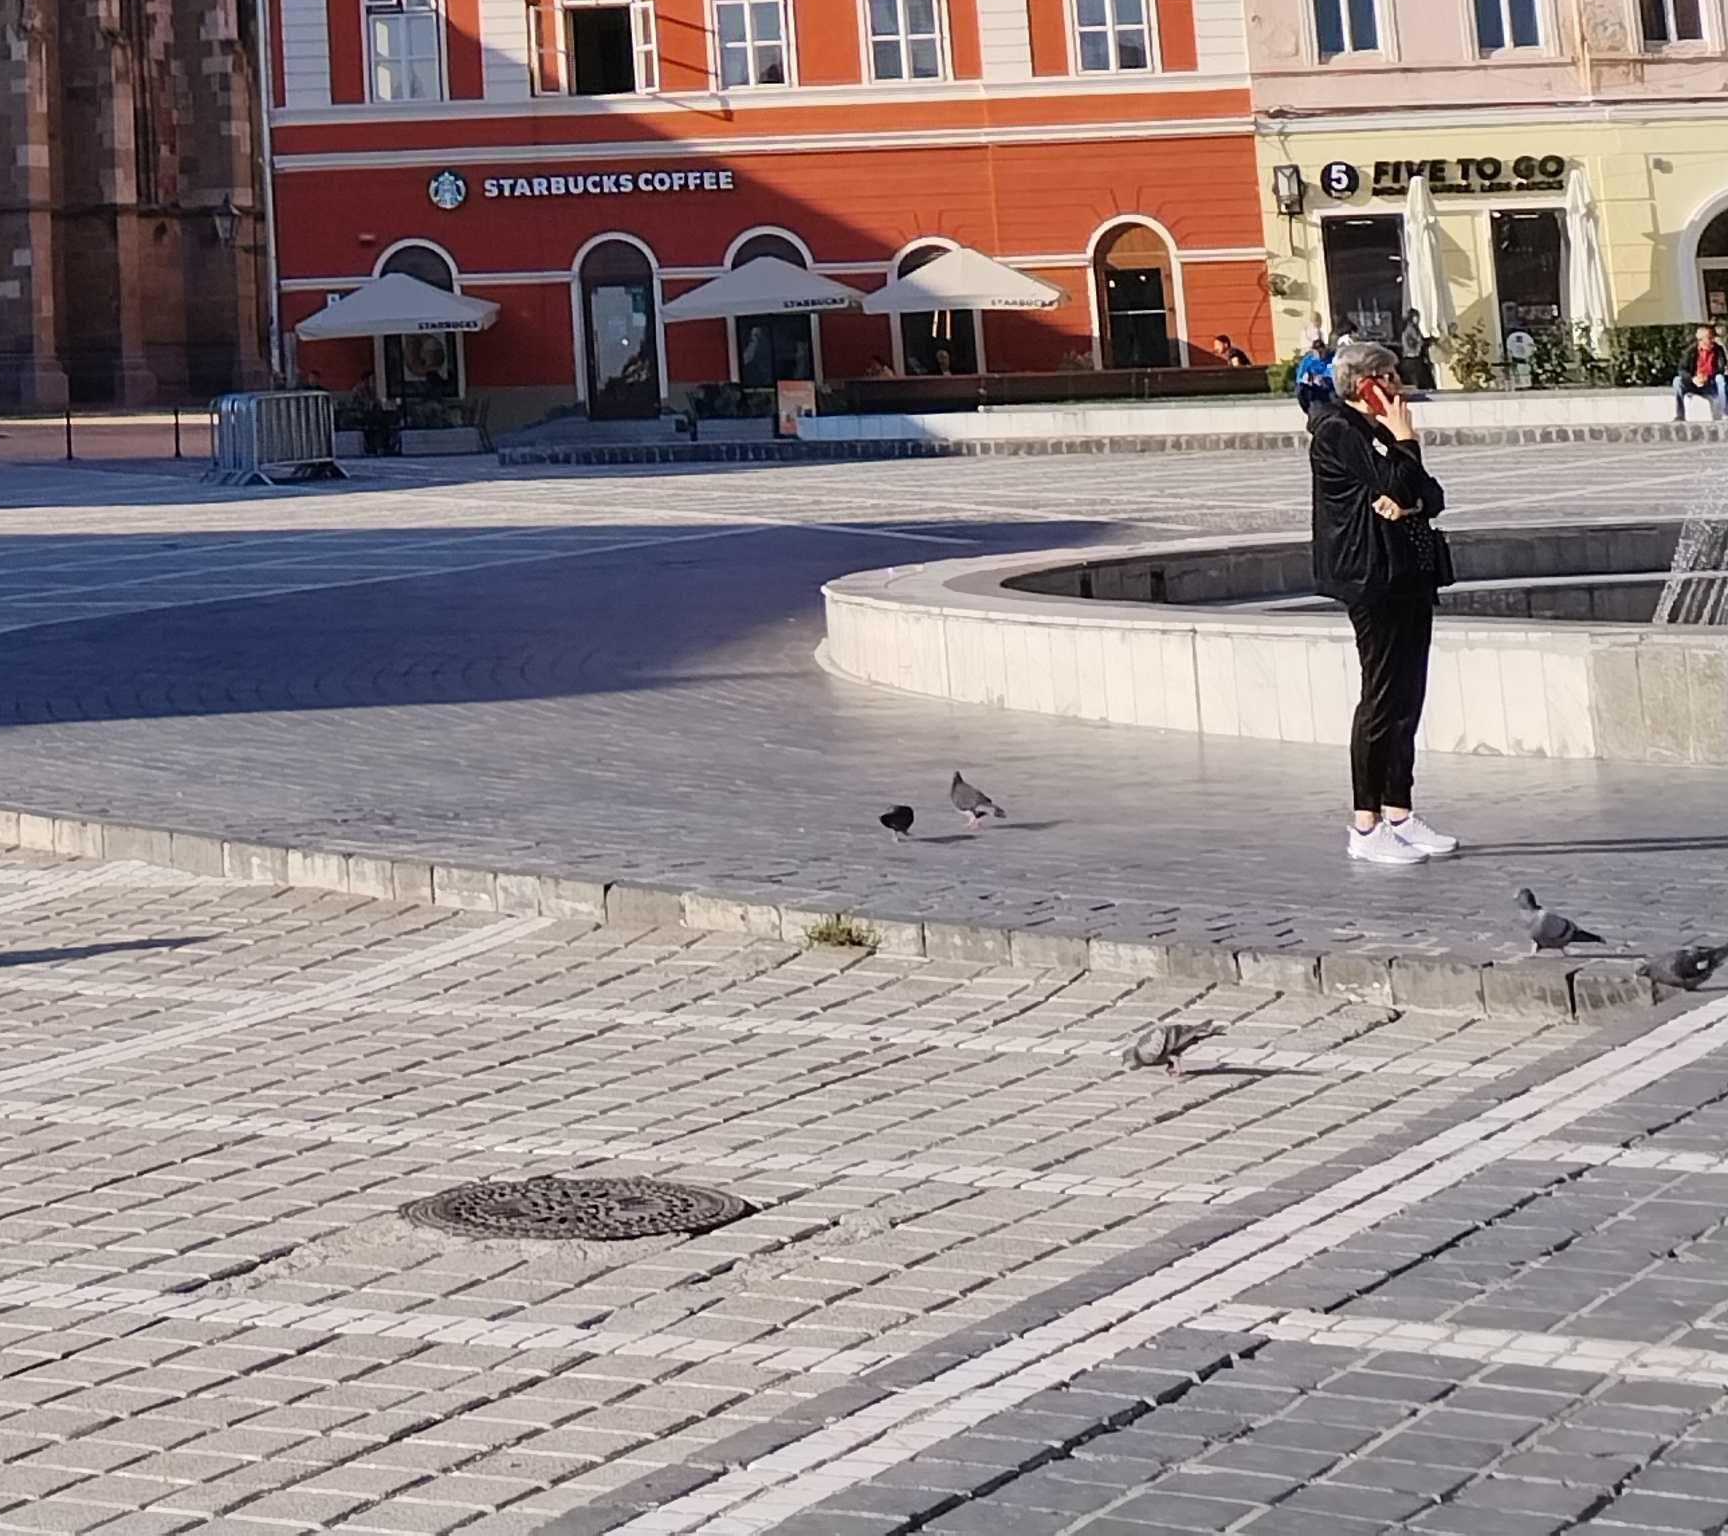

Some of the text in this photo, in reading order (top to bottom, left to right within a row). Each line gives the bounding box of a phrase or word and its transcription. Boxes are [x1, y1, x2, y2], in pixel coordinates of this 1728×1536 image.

[1330, 164, 1349, 190] 5
[1373, 155, 1565, 184] FIVE TO GO
[484, 171, 734, 198] STARBUCKS COFFEE
